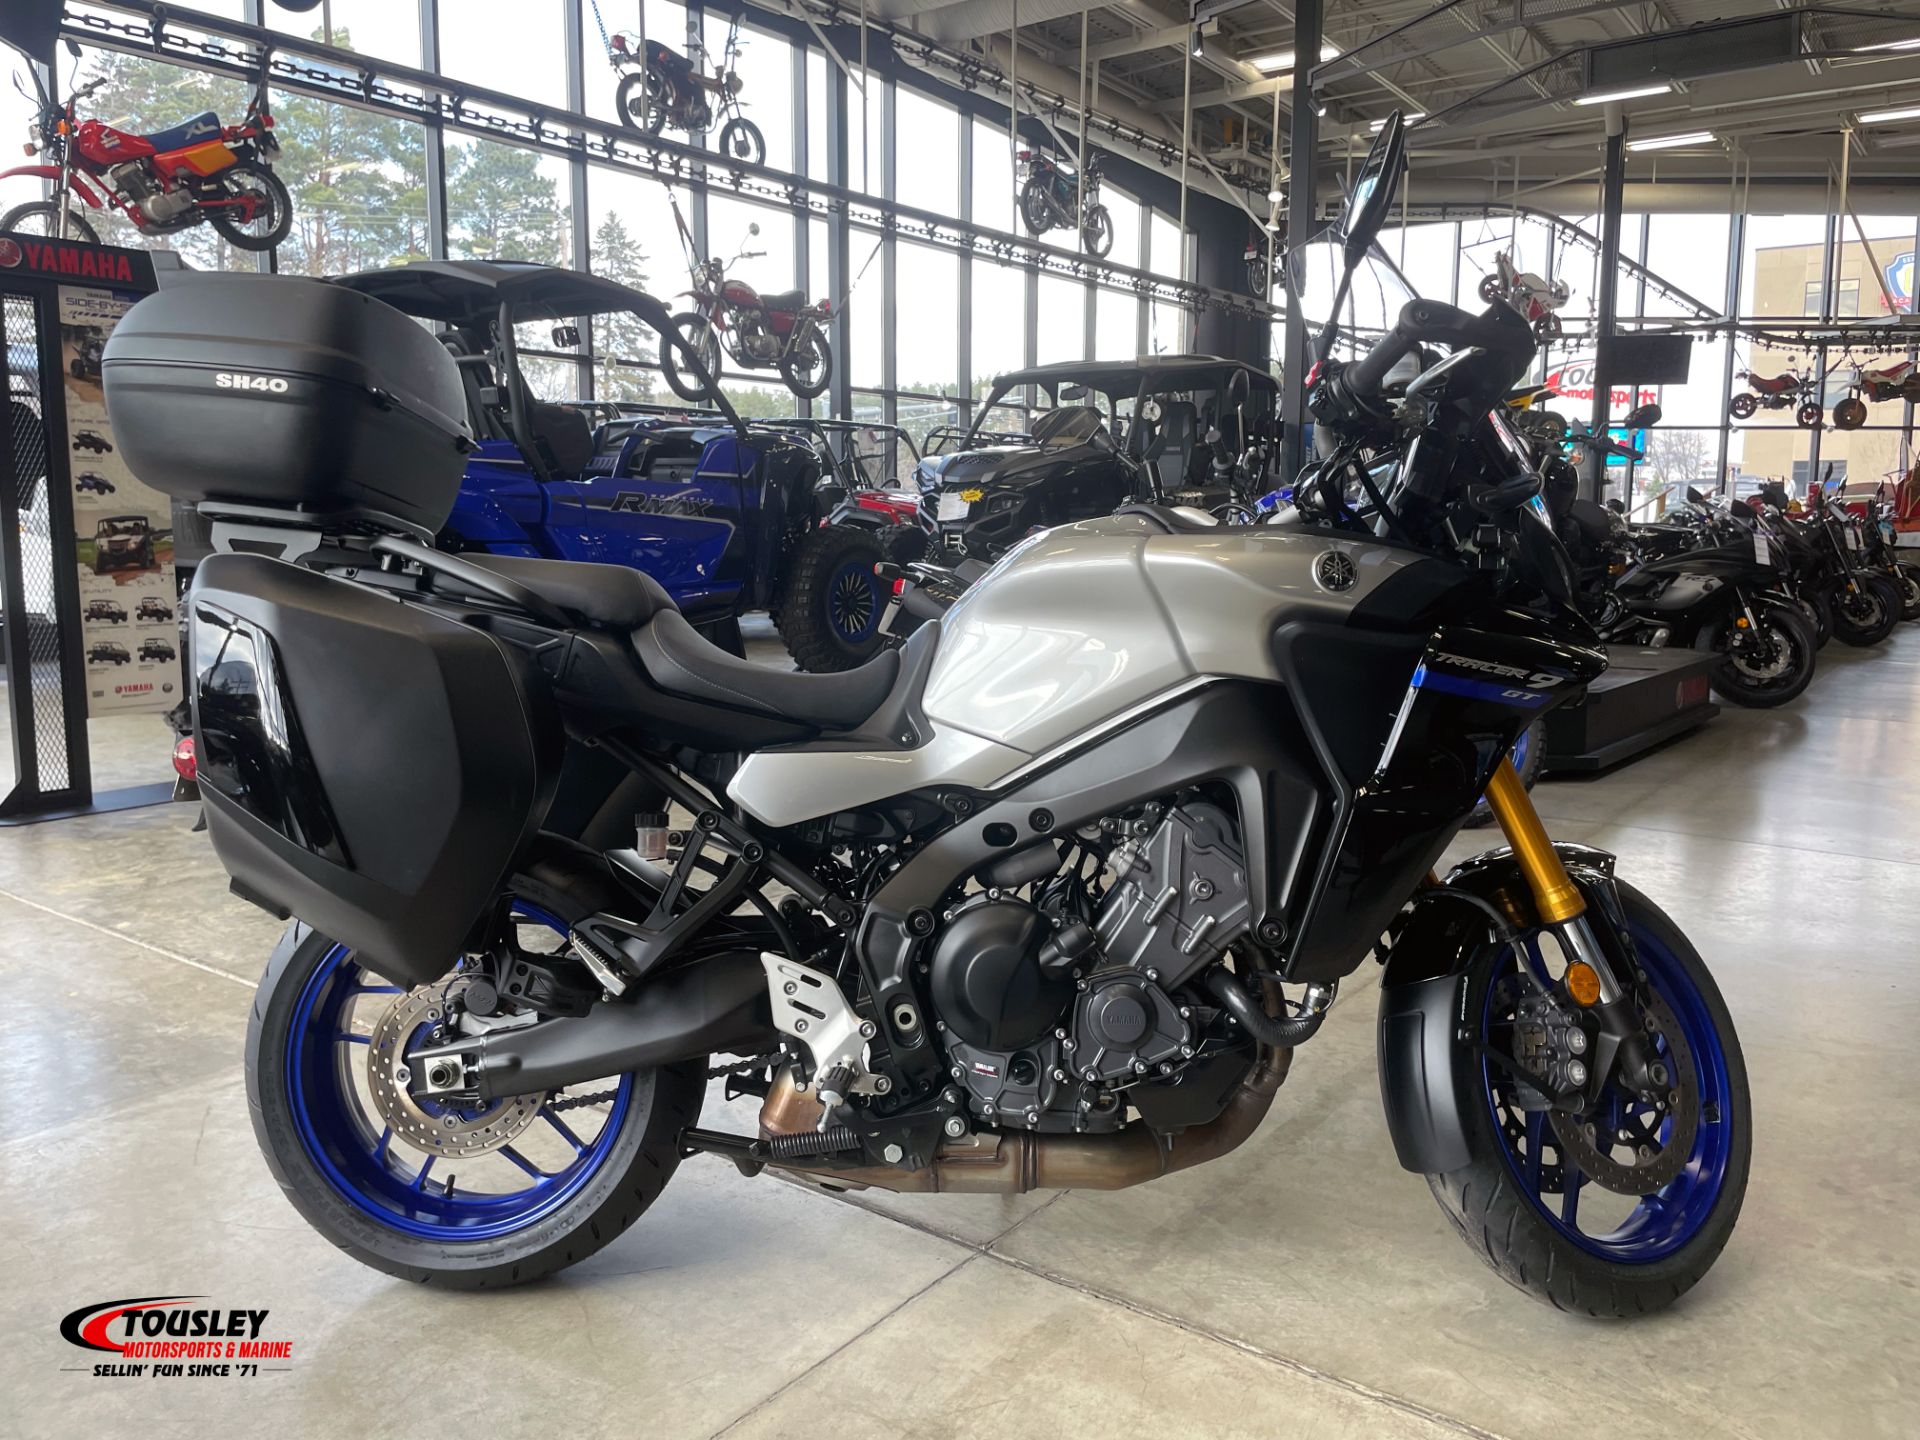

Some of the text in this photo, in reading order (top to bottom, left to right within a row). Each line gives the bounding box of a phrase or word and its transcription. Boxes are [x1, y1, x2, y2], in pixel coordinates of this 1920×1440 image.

[184, 121, 218, 140] XL
[23, 241, 132, 282] YAMAHA
[66, 297, 136, 312] SIDE-BY-S
[216, 373, 288, 393] SH40
[609, 491, 713, 517] RMAX
[1436, 652, 1564, 689] TRACER 9
[124, 683, 154, 693] YAMAHA
[1501, 690, 1541, 700] GT
